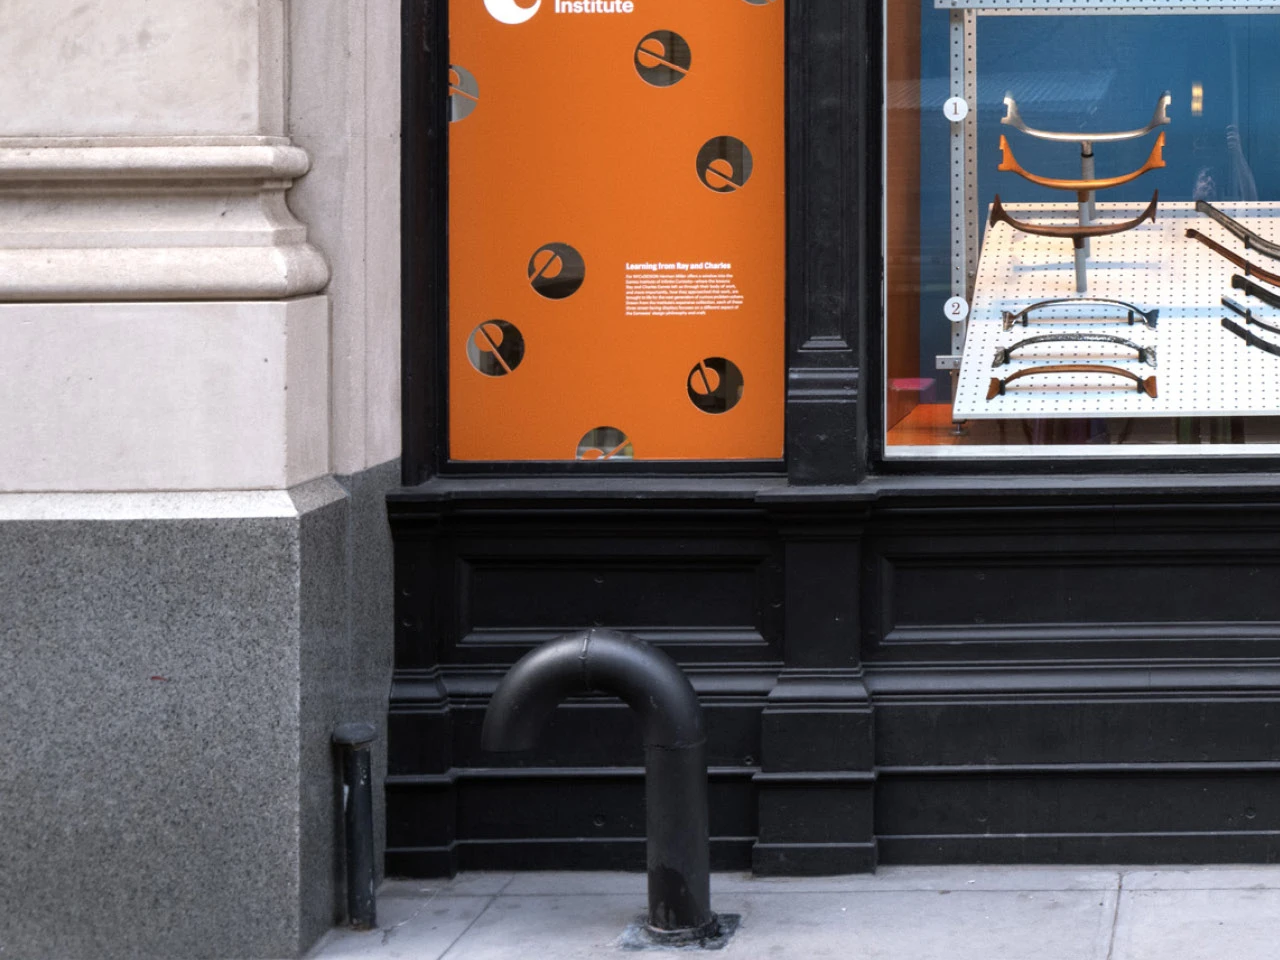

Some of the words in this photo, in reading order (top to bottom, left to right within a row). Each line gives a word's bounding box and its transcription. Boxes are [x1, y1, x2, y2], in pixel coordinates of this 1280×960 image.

[625, 262, 658, 272] Learning
[658, 262, 675, 271] from
[676, 262, 689, 271] Ray
[690, 262, 703, 270] and
[704, 262, 732, 270] Charles
[951, 302, 961, 316] 2
